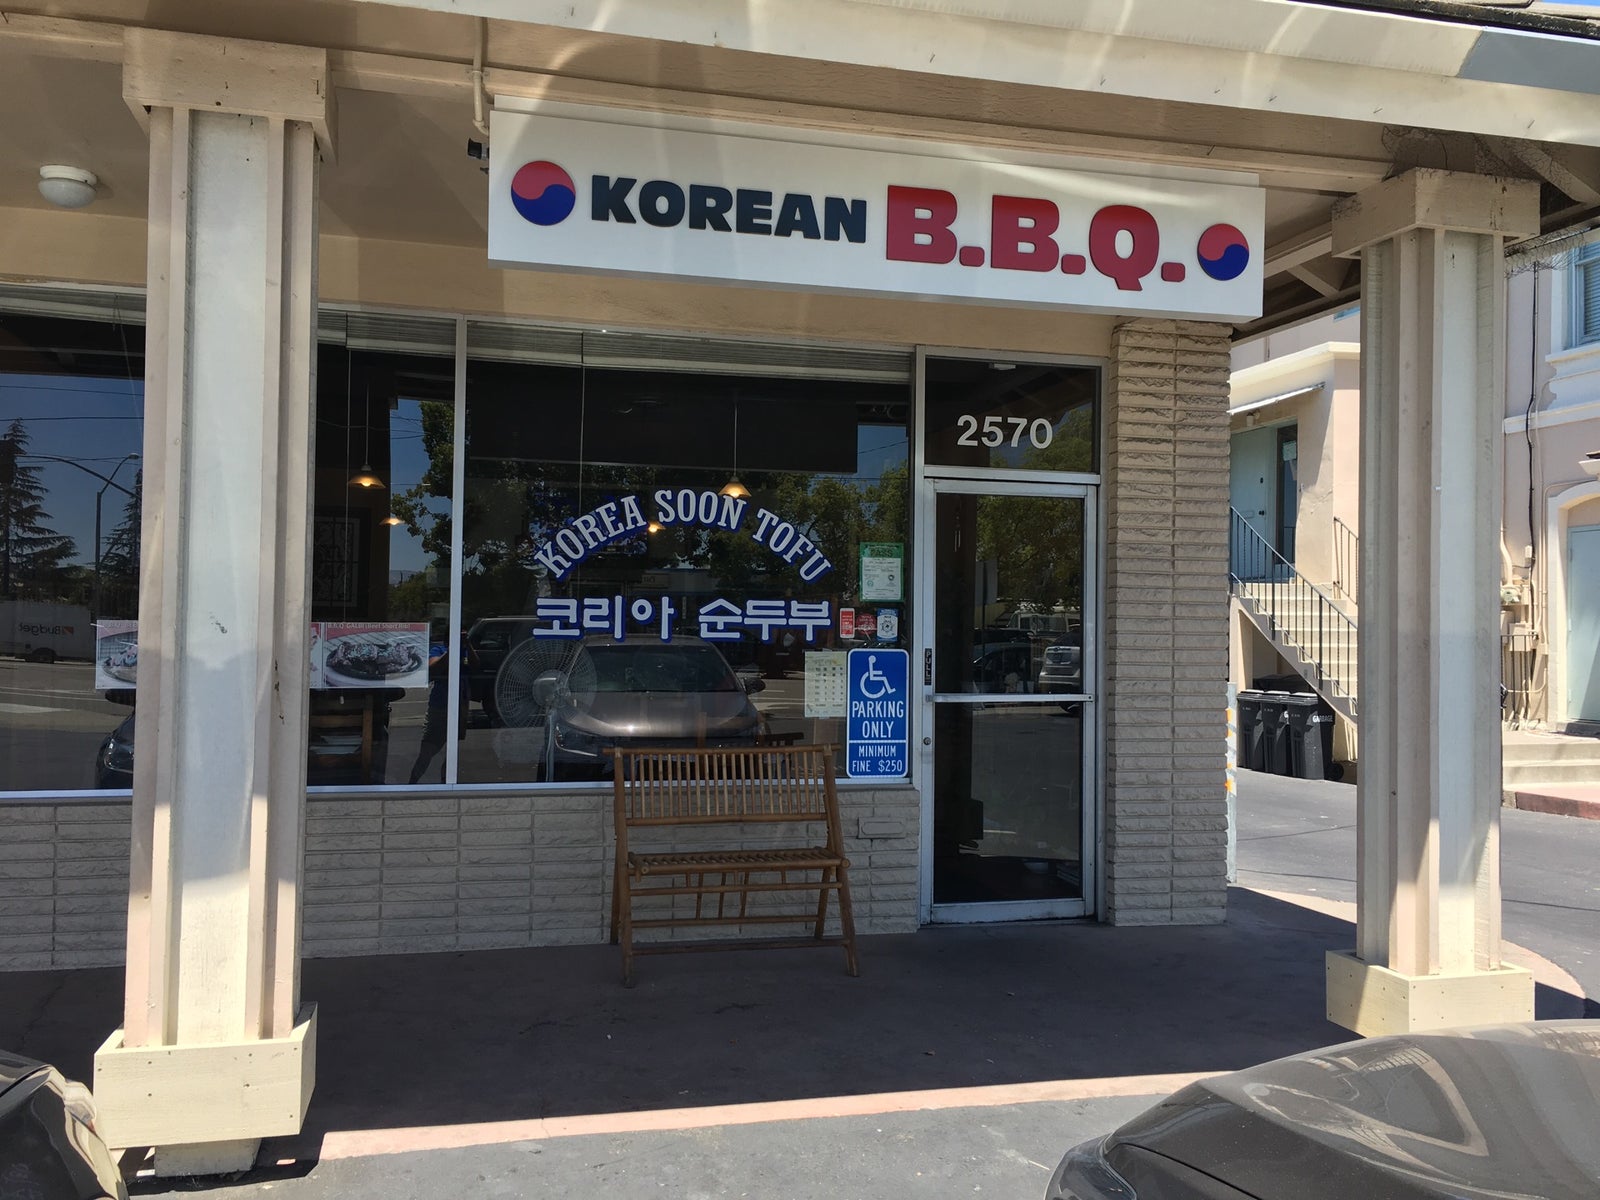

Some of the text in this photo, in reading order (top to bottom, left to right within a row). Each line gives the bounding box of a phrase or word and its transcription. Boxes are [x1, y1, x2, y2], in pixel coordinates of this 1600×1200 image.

[591, 174, 1186, 291] KOREAN B.B.Q.
[957, 414, 1053, 449] 2570
[533, 495, 647, 579] KOREA
[654, 488, 747, 530] SOON
[752, 507, 832, 581] TOFU
[532, 595, 674, 640] 코리아
[698, 598, 831, 641] 순두부
[852, 700, 904, 718] PARKING
[862, 720, 894, 738] ONLY
[858, 745, 897, 757] MINIMUM
[852, 760, 903, 773] FINE $250
